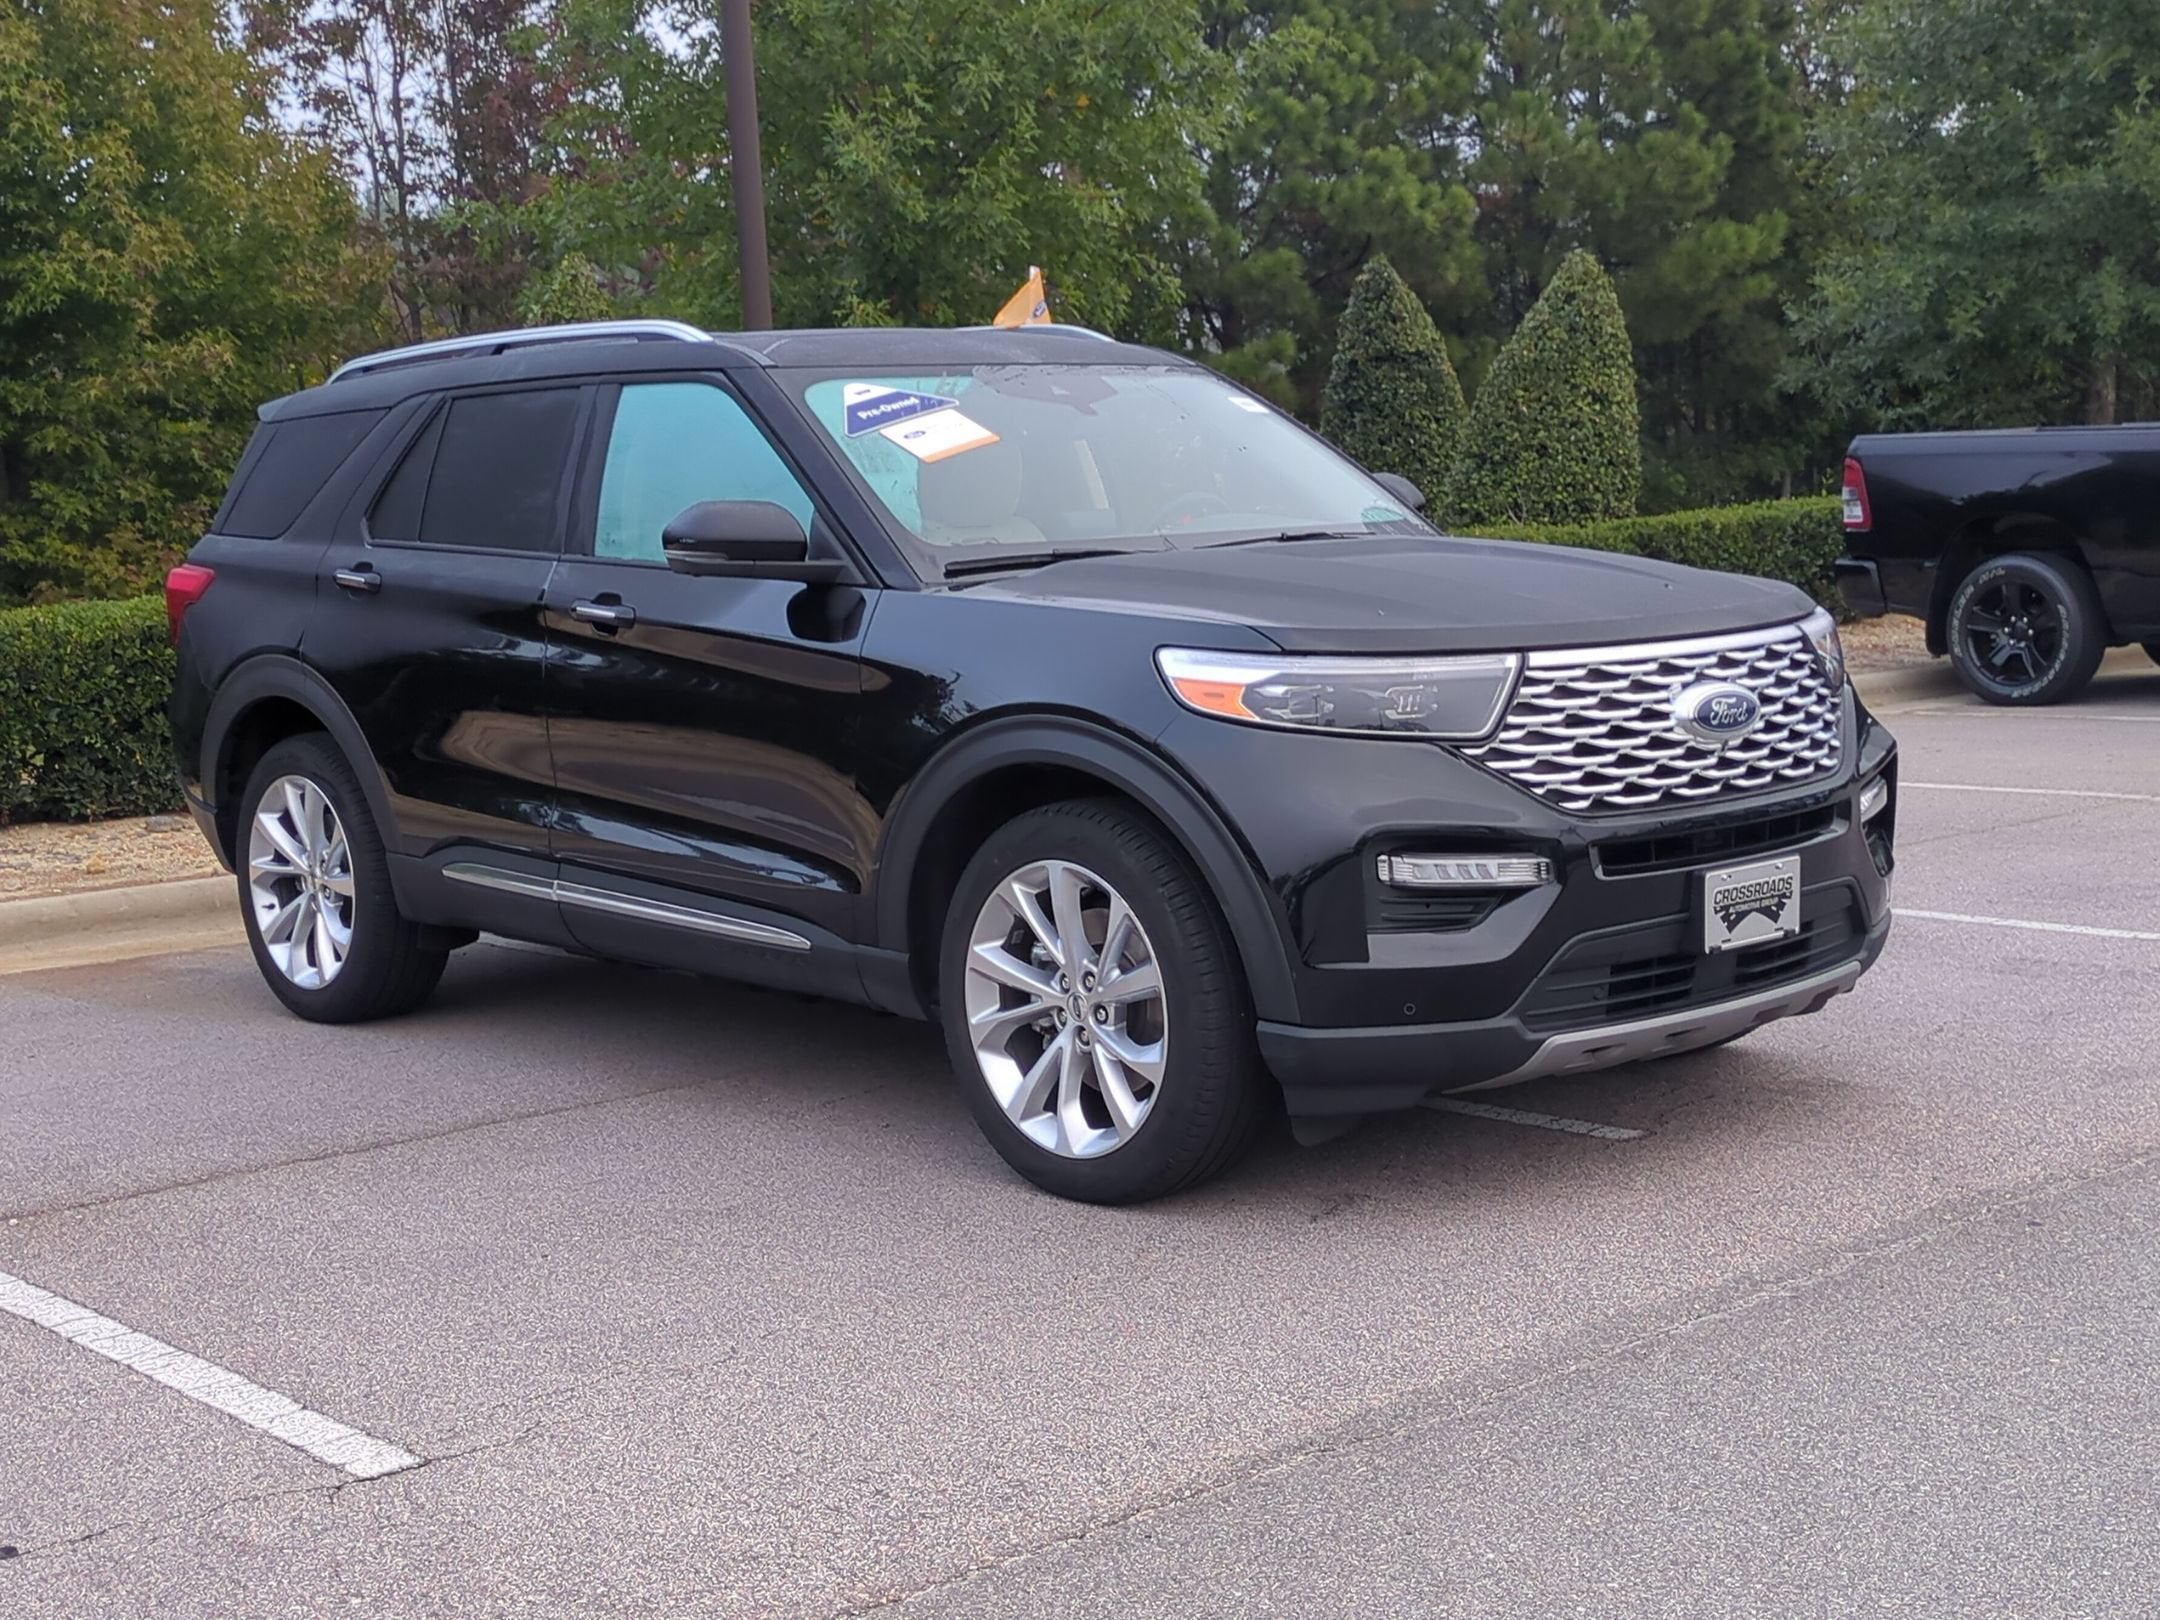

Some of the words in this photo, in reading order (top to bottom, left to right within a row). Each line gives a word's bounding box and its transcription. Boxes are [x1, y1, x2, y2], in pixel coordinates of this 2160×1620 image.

[857, 396, 920, 420] Pre-Owned
[1710, 696, 1748, 725] Ford
[1713, 875, 1793, 905] CROSSROADS
